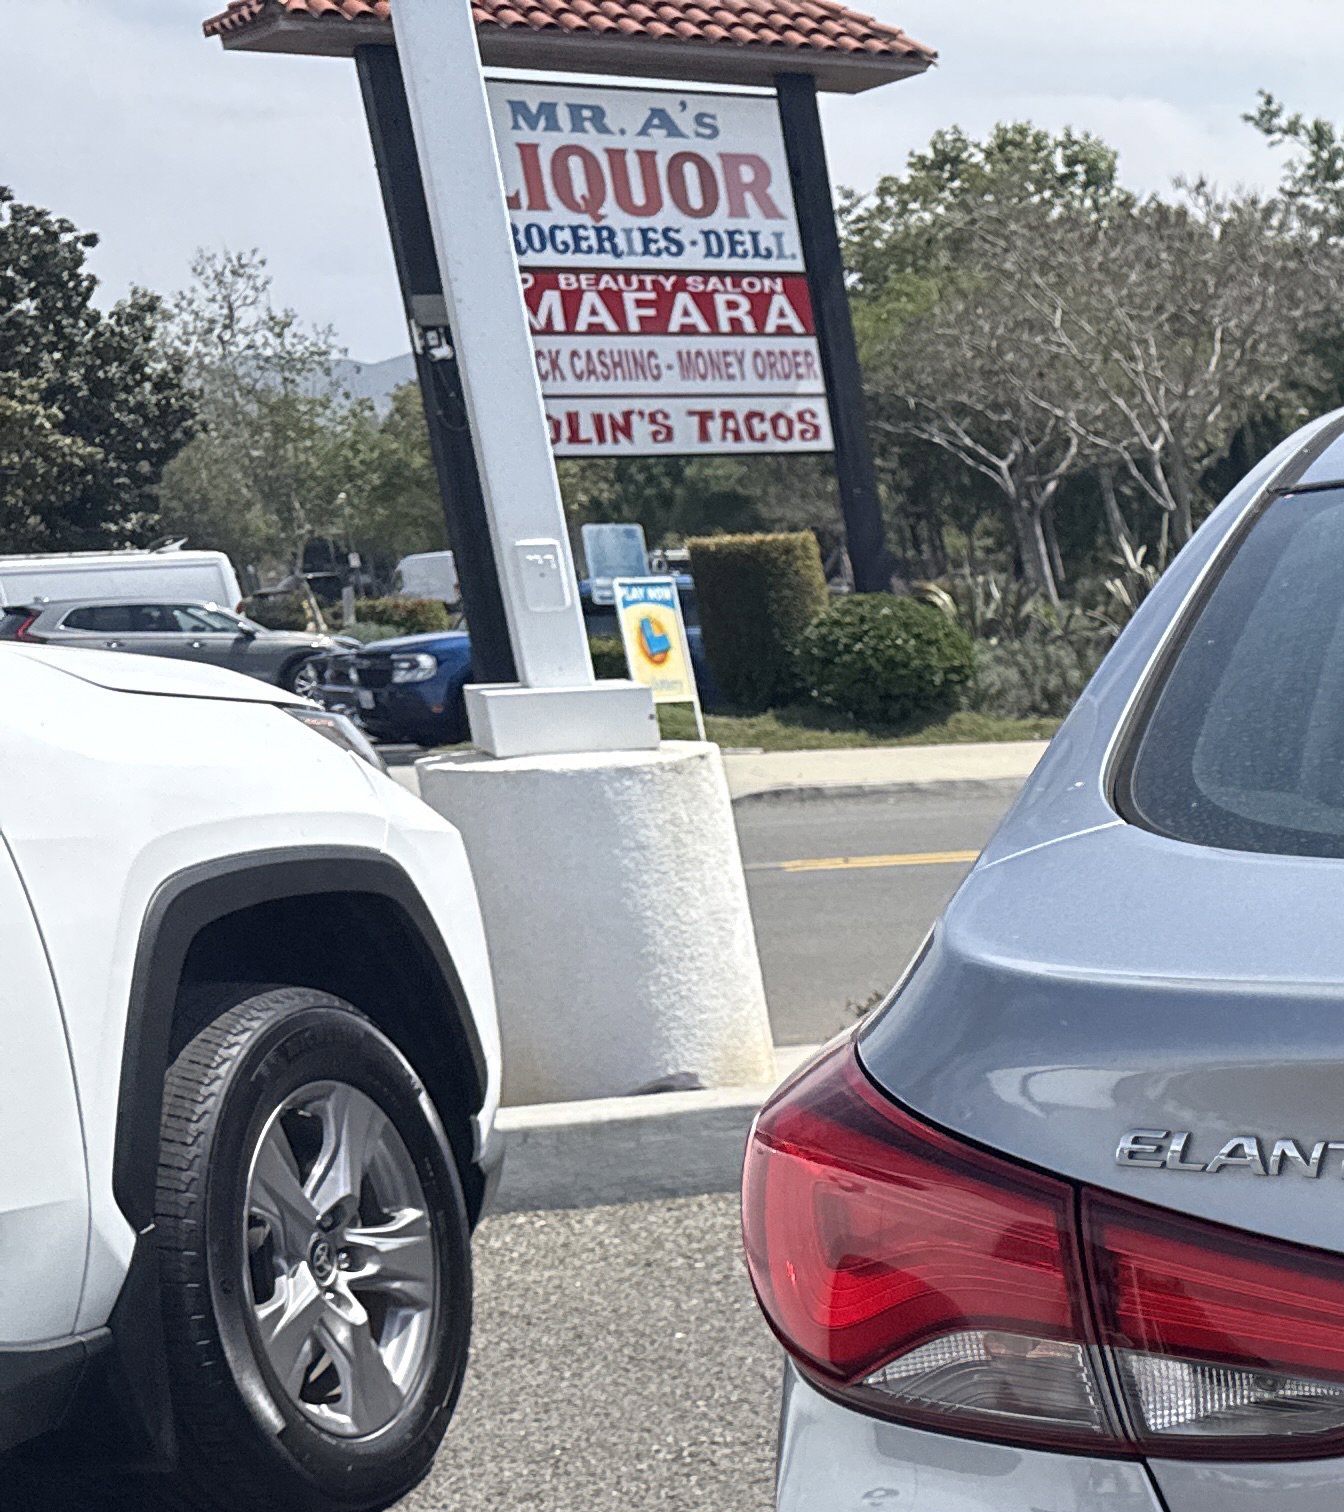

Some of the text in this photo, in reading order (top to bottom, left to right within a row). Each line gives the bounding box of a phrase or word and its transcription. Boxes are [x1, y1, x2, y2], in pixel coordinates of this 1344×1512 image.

[506, 99, 626, 136] MR.
[506, 142, 789, 223] IQUOR
[511, 222, 685, 259] OCERIES
[557, 271, 678, 292] BEAUTY
[685, 275, 784, 294] SALON
[569, 348, 662, 382] CASHING
[676, 349, 746, 382] MONEY
[752, 349, 818, 382] ORDER
[546, 407, 821, 445] OLIN'S TACOS
